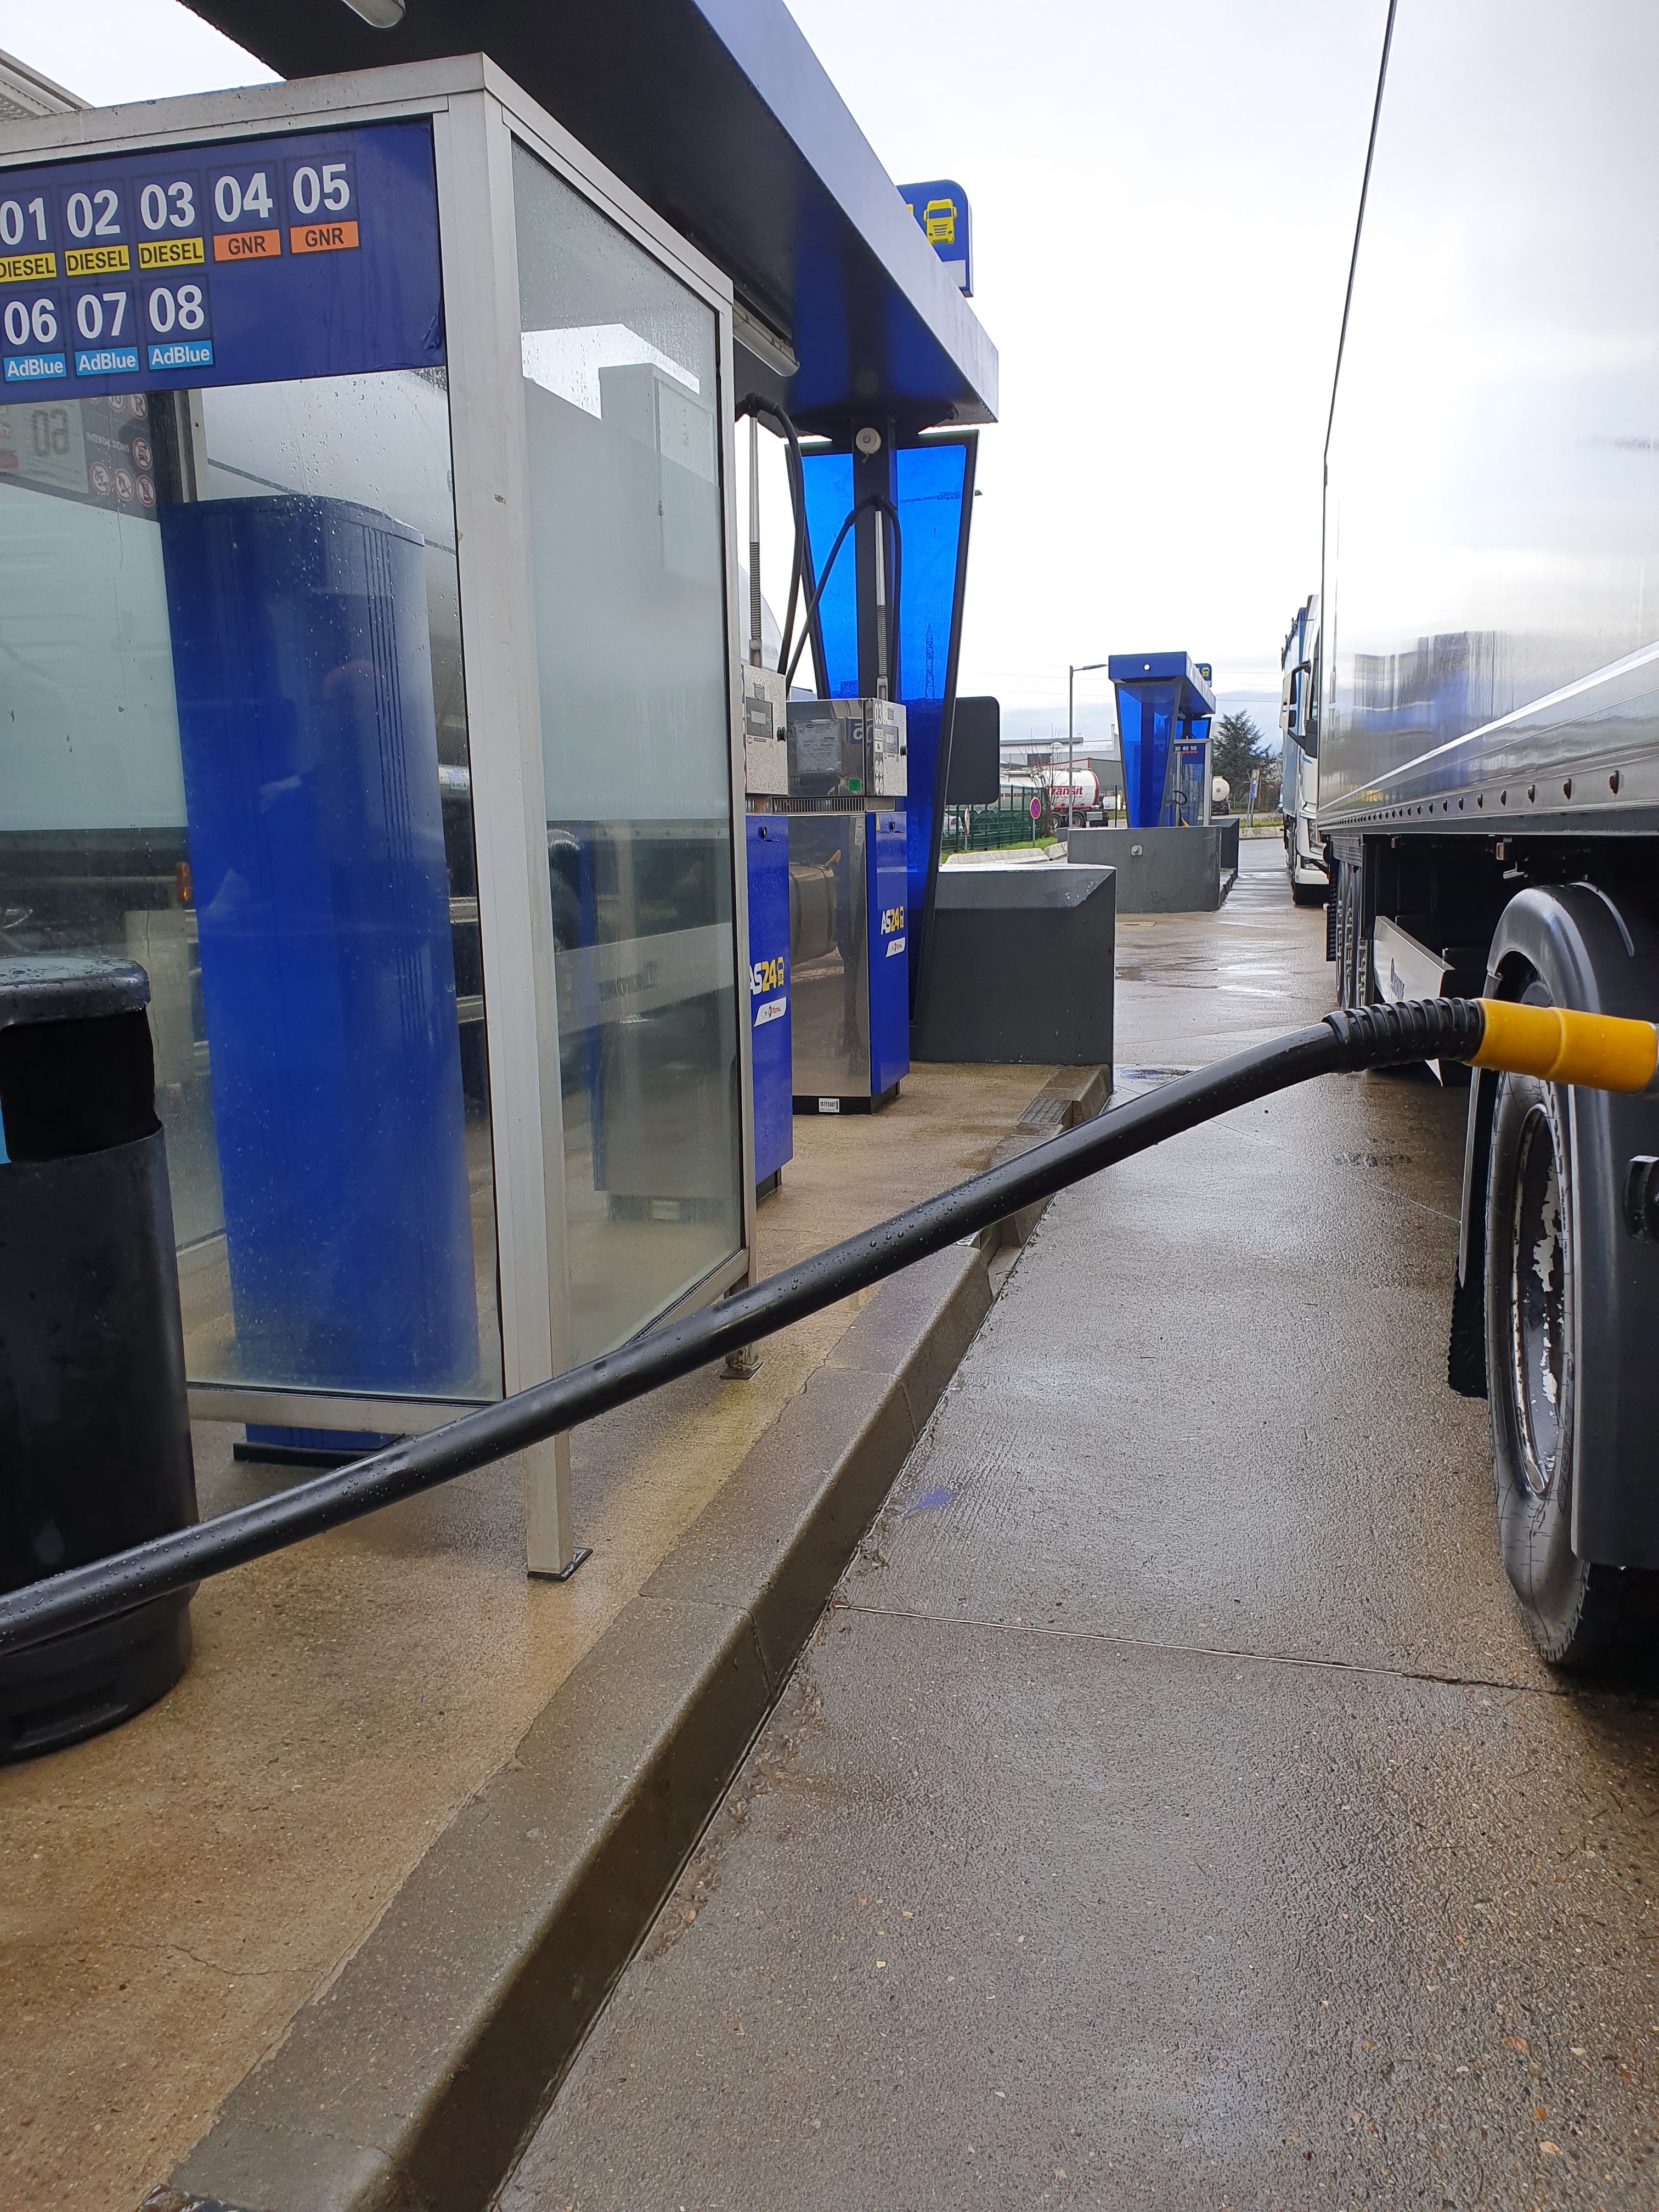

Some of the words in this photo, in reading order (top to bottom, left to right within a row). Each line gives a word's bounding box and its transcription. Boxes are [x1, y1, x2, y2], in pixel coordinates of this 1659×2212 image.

[0, 198, 47, 245] 01
[66, 189, 121, 238] 02
[140, 181, 195, 230] 03
[215, 172, 273, 223] 04
[292, 163, 350, 214] 05
[67, 250, 128, 271] DIESEL
[140, 242, 202, 264] DIESEL
[228, 235, 267, 256] GNR
[304, 227, 345, 247] GNR
[4, 298, 57, 345] 06
[77, 292, 127, 338] 07
[149, 285, 205, 332] 08
[7, 359, 64, 377] AdBlue
[79, 353, 137, 371] AdBlue
[151, 346, 211, 365] AdBlue
[874, 702, 882, 725] 03
[881, 907, 900, 935] AS24
